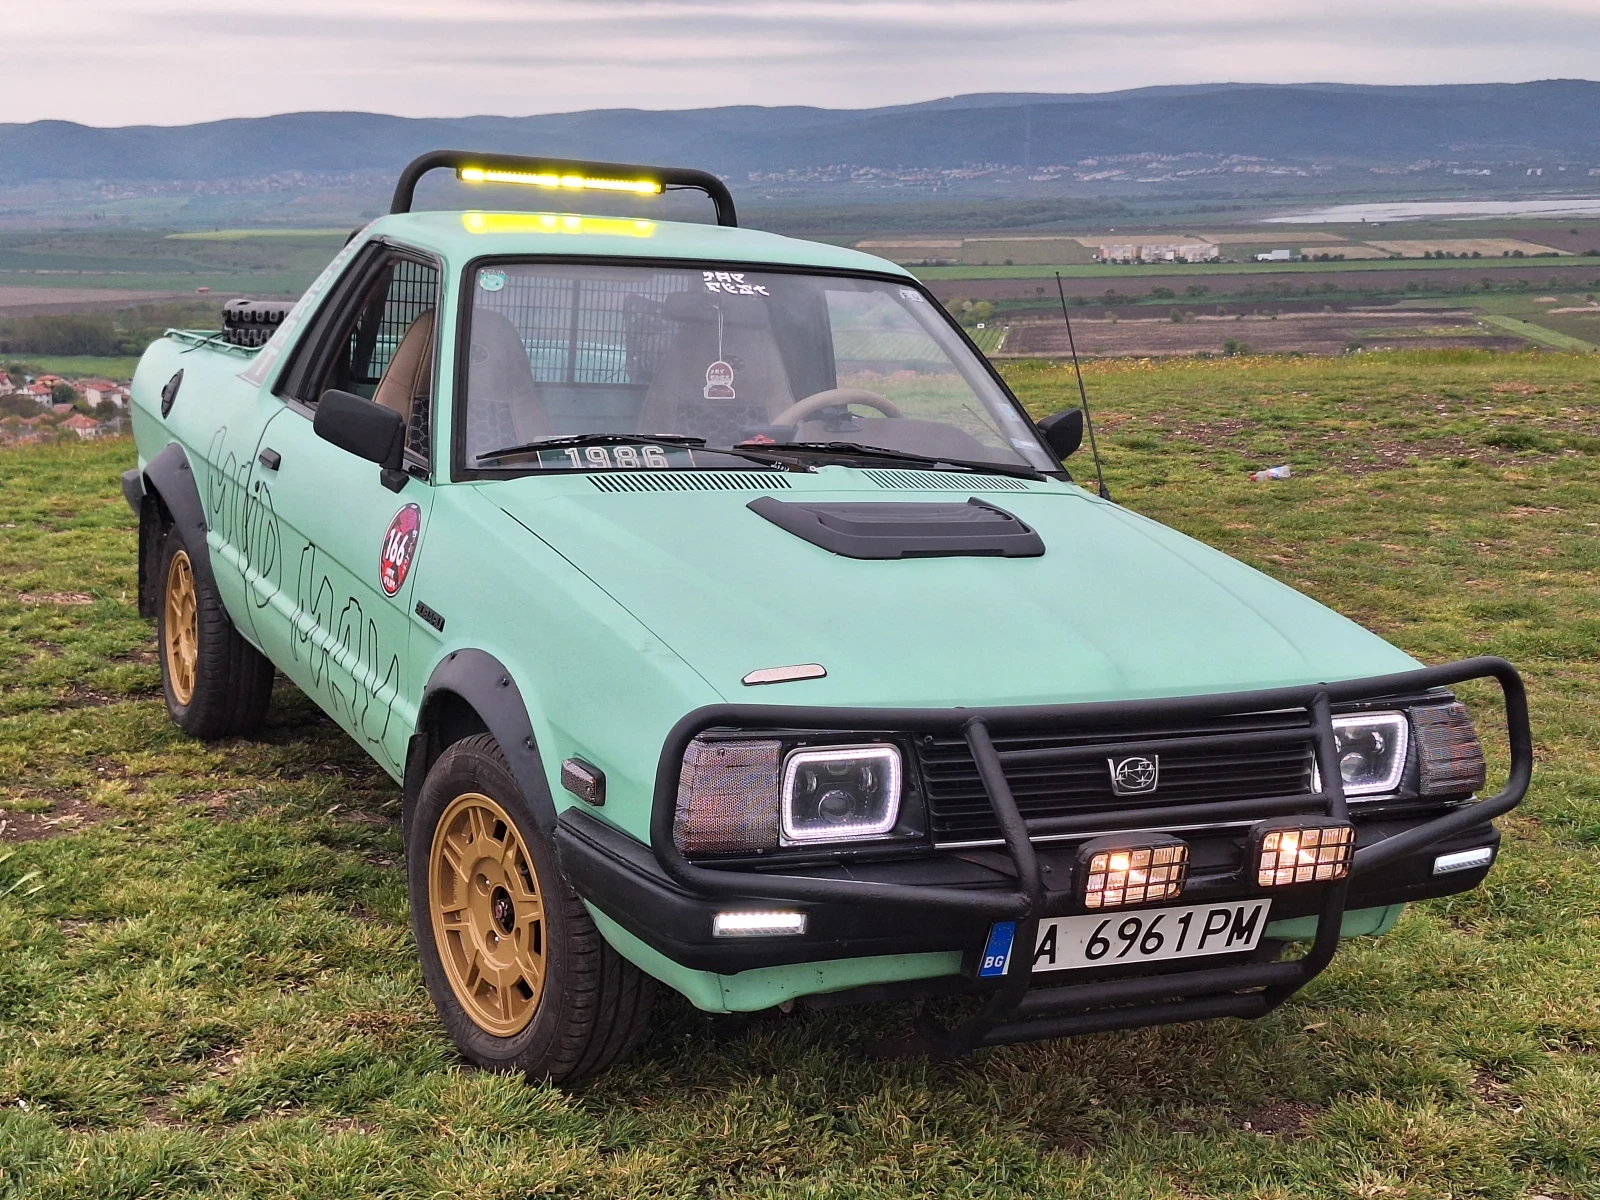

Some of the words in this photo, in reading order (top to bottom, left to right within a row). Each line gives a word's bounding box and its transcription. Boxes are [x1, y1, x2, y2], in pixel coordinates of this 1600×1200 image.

[564, 445, 670, 468] 1986
[385, 528, 409, 566] 166
[1033, 924, 1058, 965] A
[1085, 912, 1193, 960] 6961
[983, 955, 1005, 969] BG
